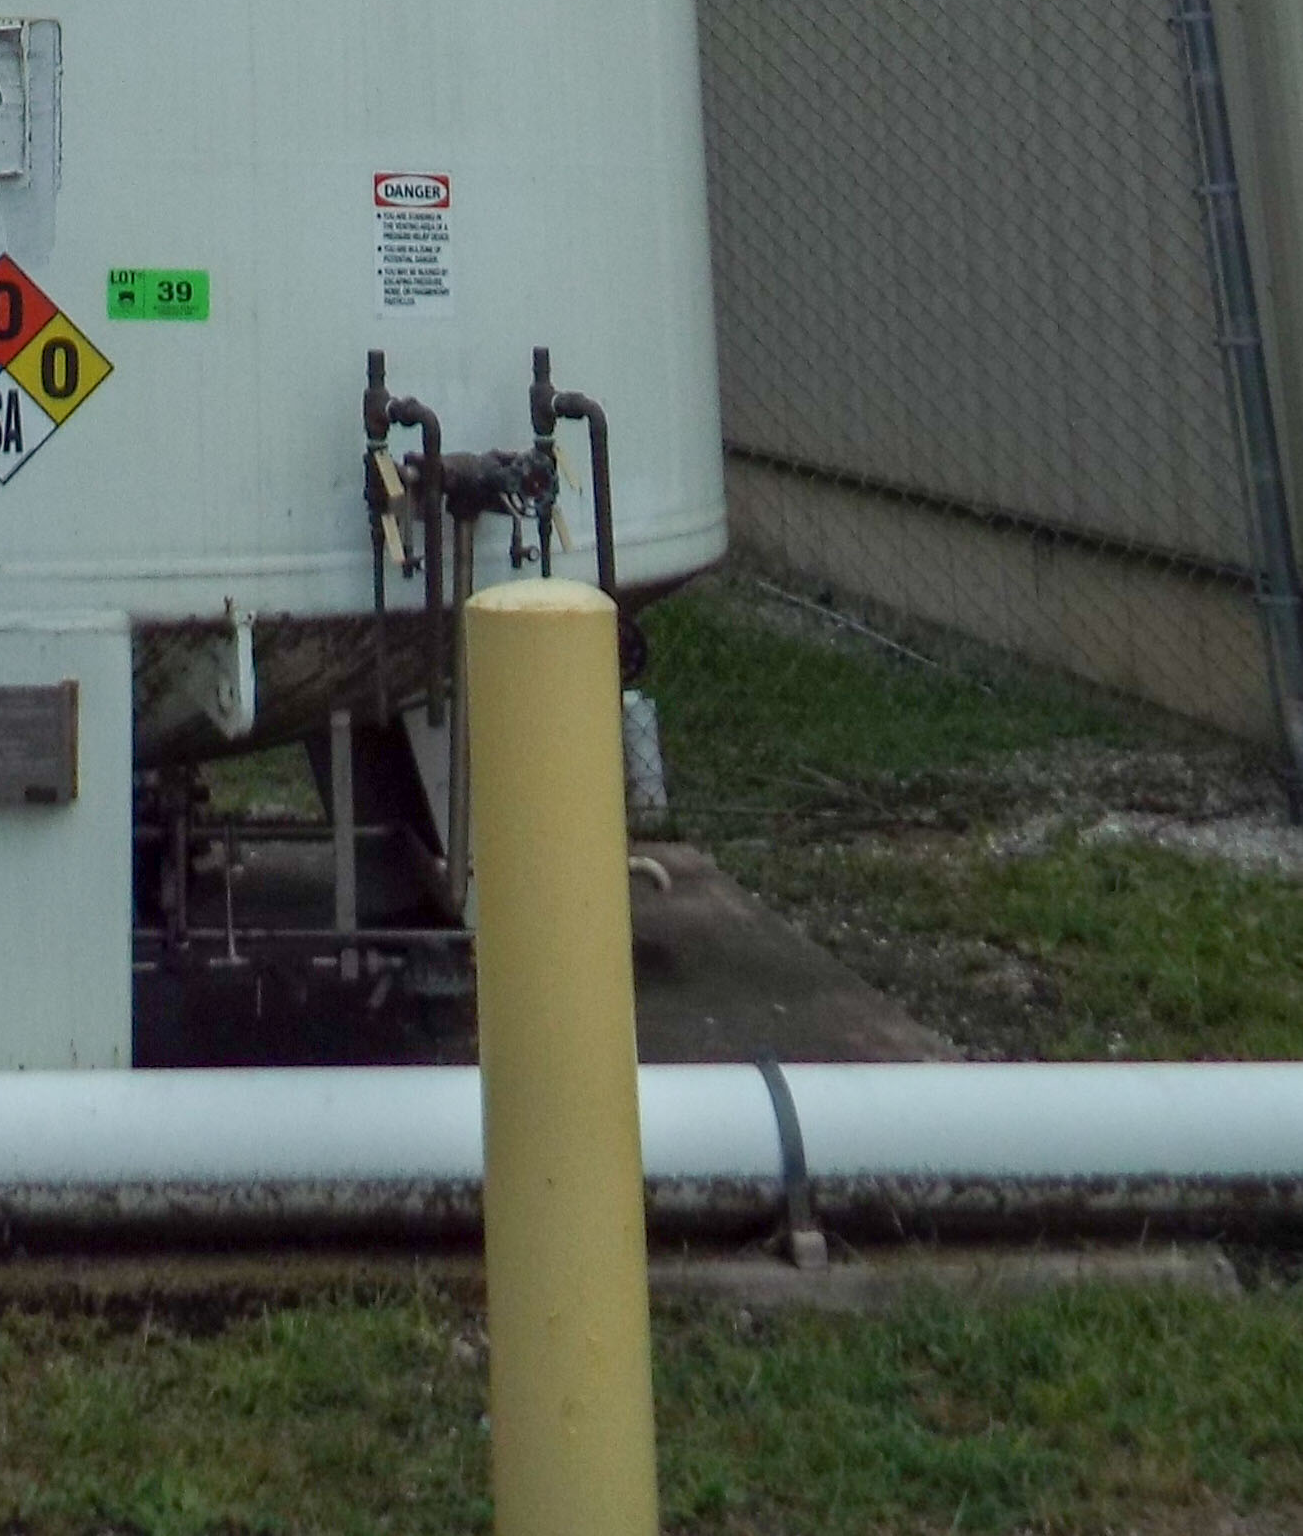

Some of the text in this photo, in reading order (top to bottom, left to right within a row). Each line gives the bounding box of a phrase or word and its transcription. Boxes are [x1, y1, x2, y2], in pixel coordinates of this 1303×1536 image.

[384, 183, 441, 199] DANGER
[110, 269, 138, 285] LOT
[157, 280, 193, 304] 39
[40, 336, 79, 400] 0
